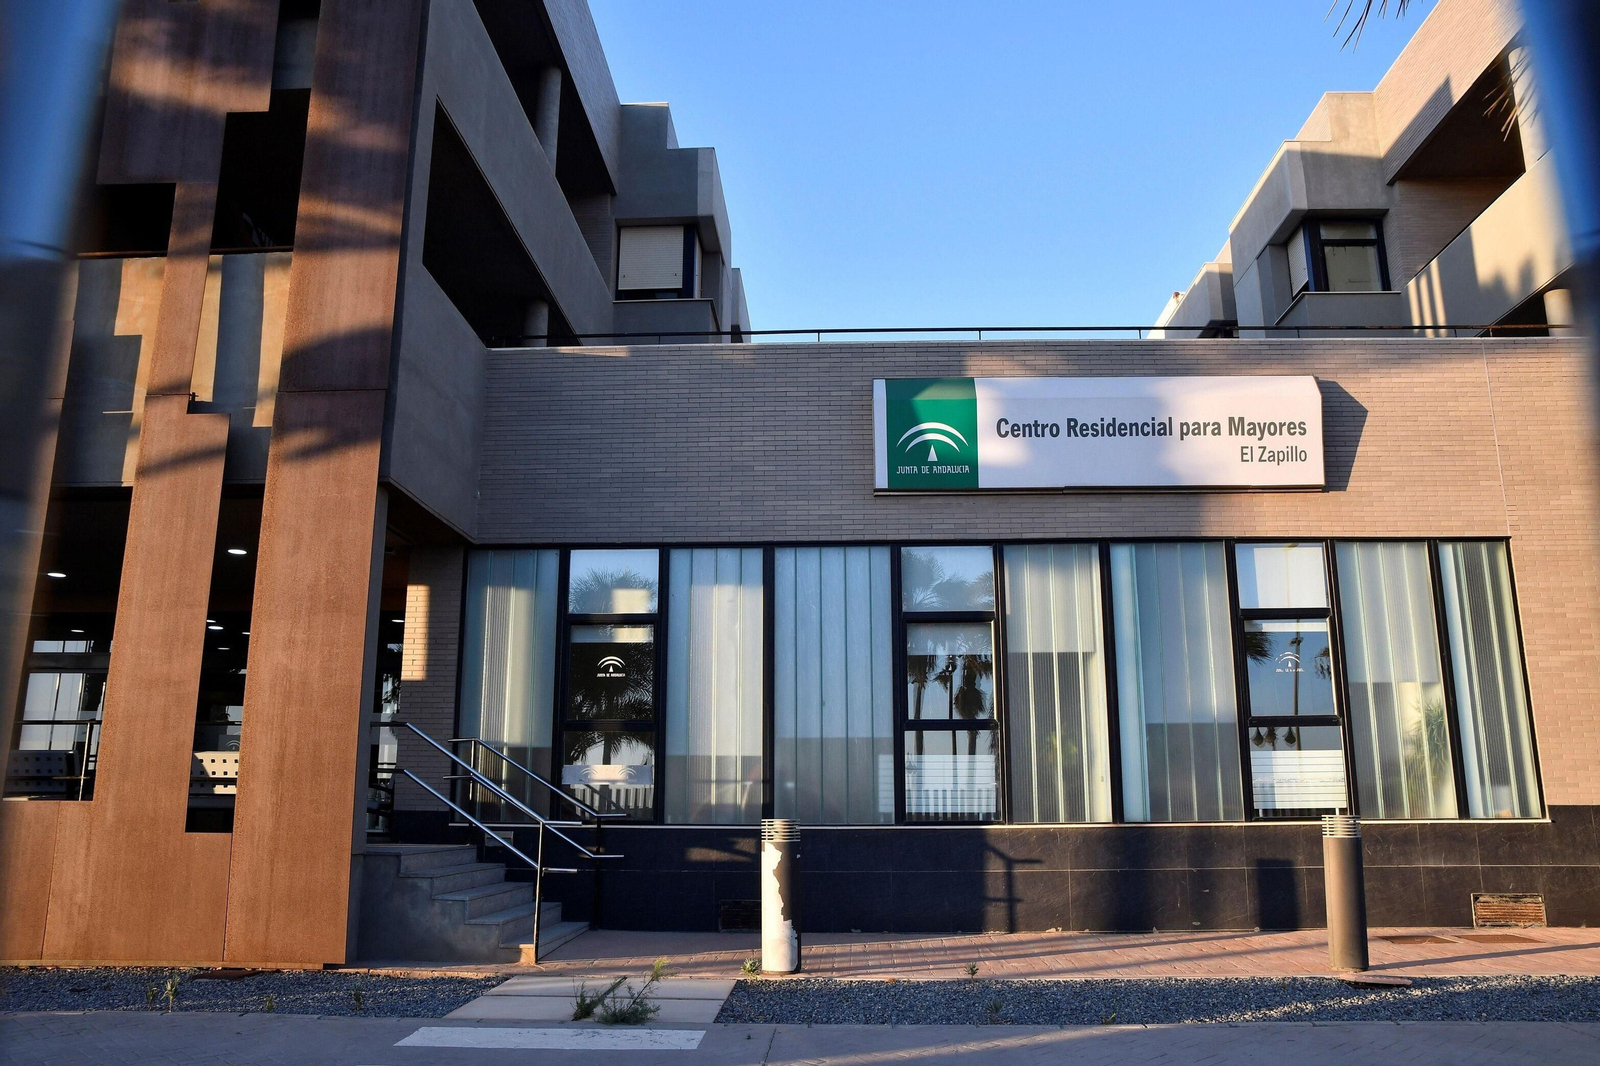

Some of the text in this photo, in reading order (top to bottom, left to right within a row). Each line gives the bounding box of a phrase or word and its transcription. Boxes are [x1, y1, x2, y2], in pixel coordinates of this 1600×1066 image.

[996, 416, 1307, 441] Centro Residencial para Mayores
[1240, 445, 1308, 466] El Zapillo
[896, 465, 970, 474] JUNTA DE ANDALUCIA
